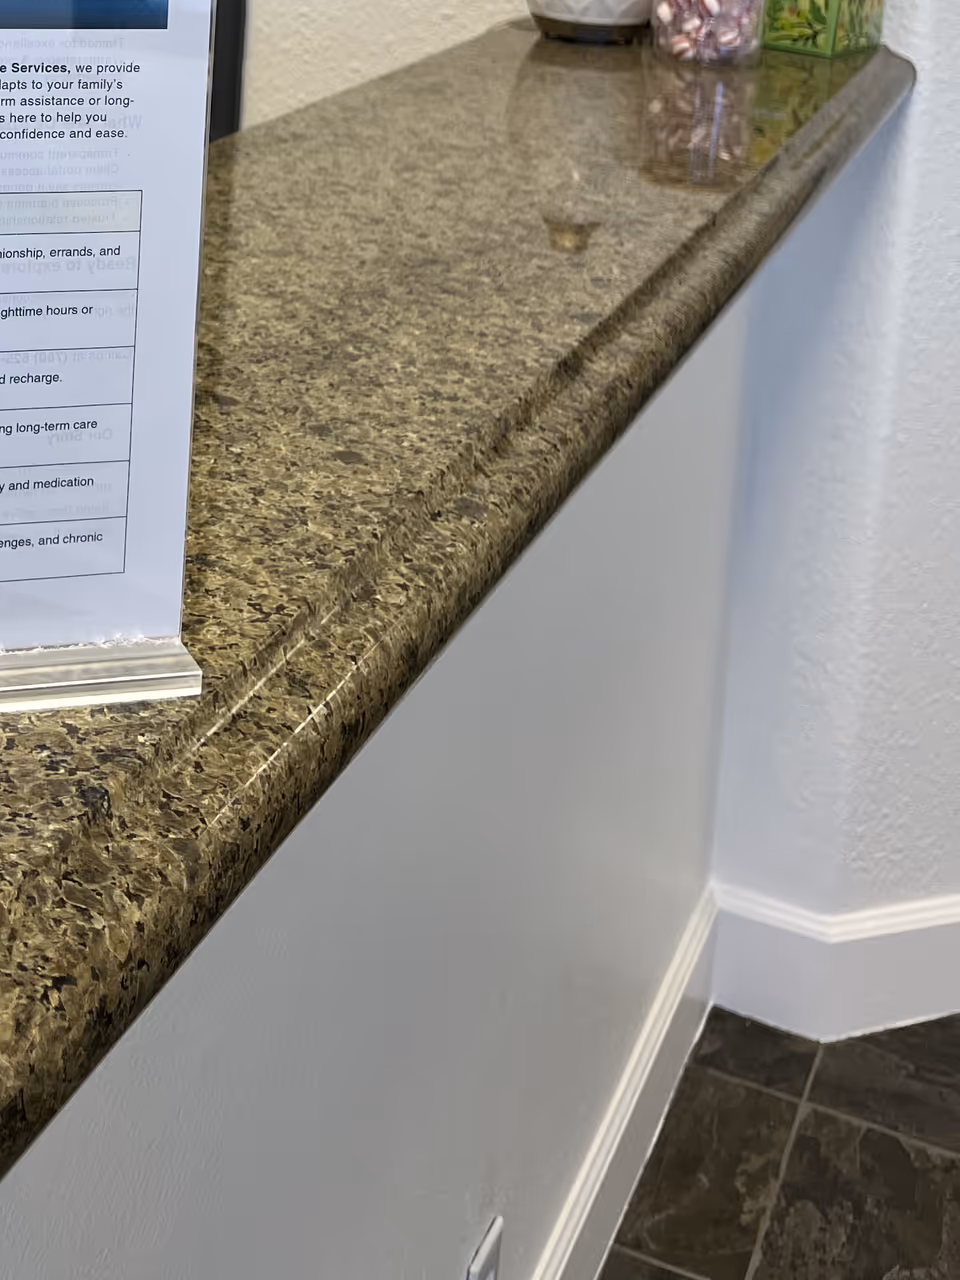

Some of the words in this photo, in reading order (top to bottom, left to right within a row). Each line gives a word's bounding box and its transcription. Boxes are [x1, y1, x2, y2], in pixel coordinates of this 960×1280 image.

[11, 61, 70, 74] Services,
[75, 64, 92, 73] we
[96, 60, 140, 75] provide
[31, 79, 42, 89] to
[45, 77, 74, 92] your
[77, 78, 123, 92] family's
[19, 94, 84, 106] assistance
[88, 97, 101, 105] or
[104, 94, 134, 108] long-
[9, 111, 36, 123] here
[40, 112, 52, 122] to
[56, 111, 81, 124] help
[84, 112, 107, 124] you
[0, 126, 65, 139] confidence
[68, 127, 91, 138] and
[95, 126, 127, 138] ease.
[49, 243, 95, 258] errands,
[98, 244, 120, 256] and
[45, 304, 78, 315] hours
[78, 307, 93, 316] or
[9, 369, 62, 385] recharge.
[13, 421, 70, 436] long-term
[72, 420, 97, 429] care
[7, 479, 29, 491] and
[32, 476, 94, 489] medication
[37, 533, 59, 545] and
[62, 531, 103, 543] chronic
